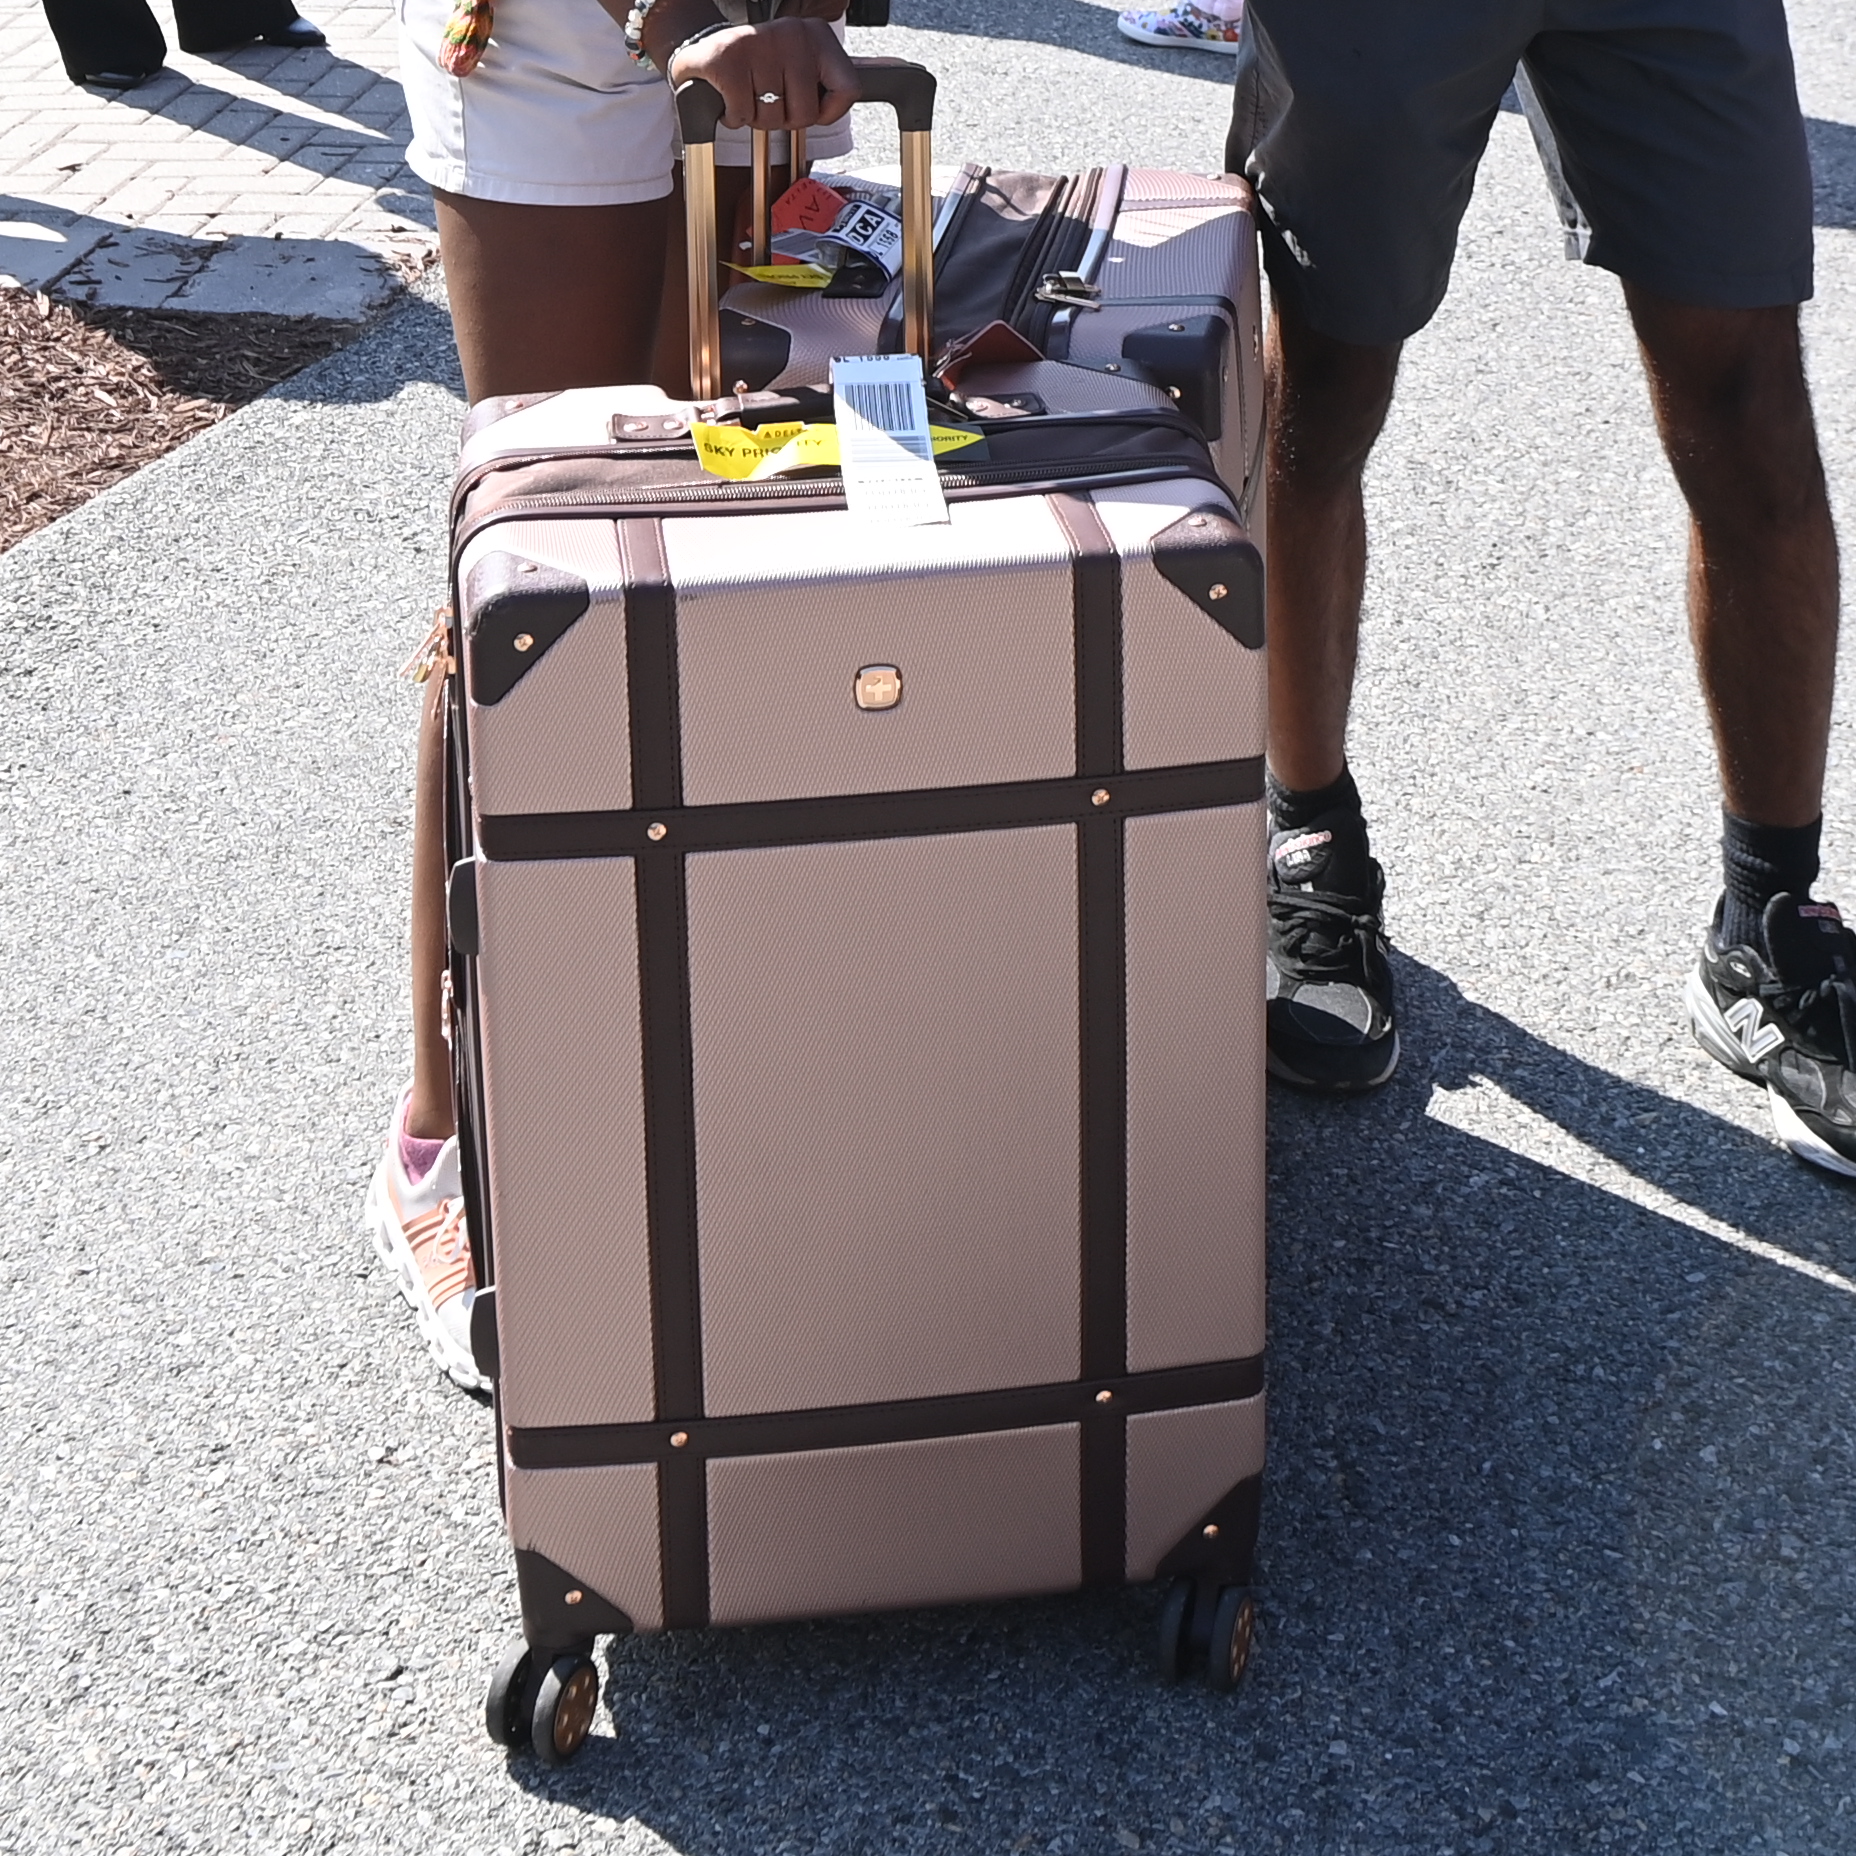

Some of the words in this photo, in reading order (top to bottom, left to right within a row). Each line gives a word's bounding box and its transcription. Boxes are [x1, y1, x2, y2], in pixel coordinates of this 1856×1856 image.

[846, 213, 883, 246] DCA
[774, 428, 808, 438] DELT
[703, 442, 735, 458] SKY
[741, 439, 823, 459] PRIOITY
